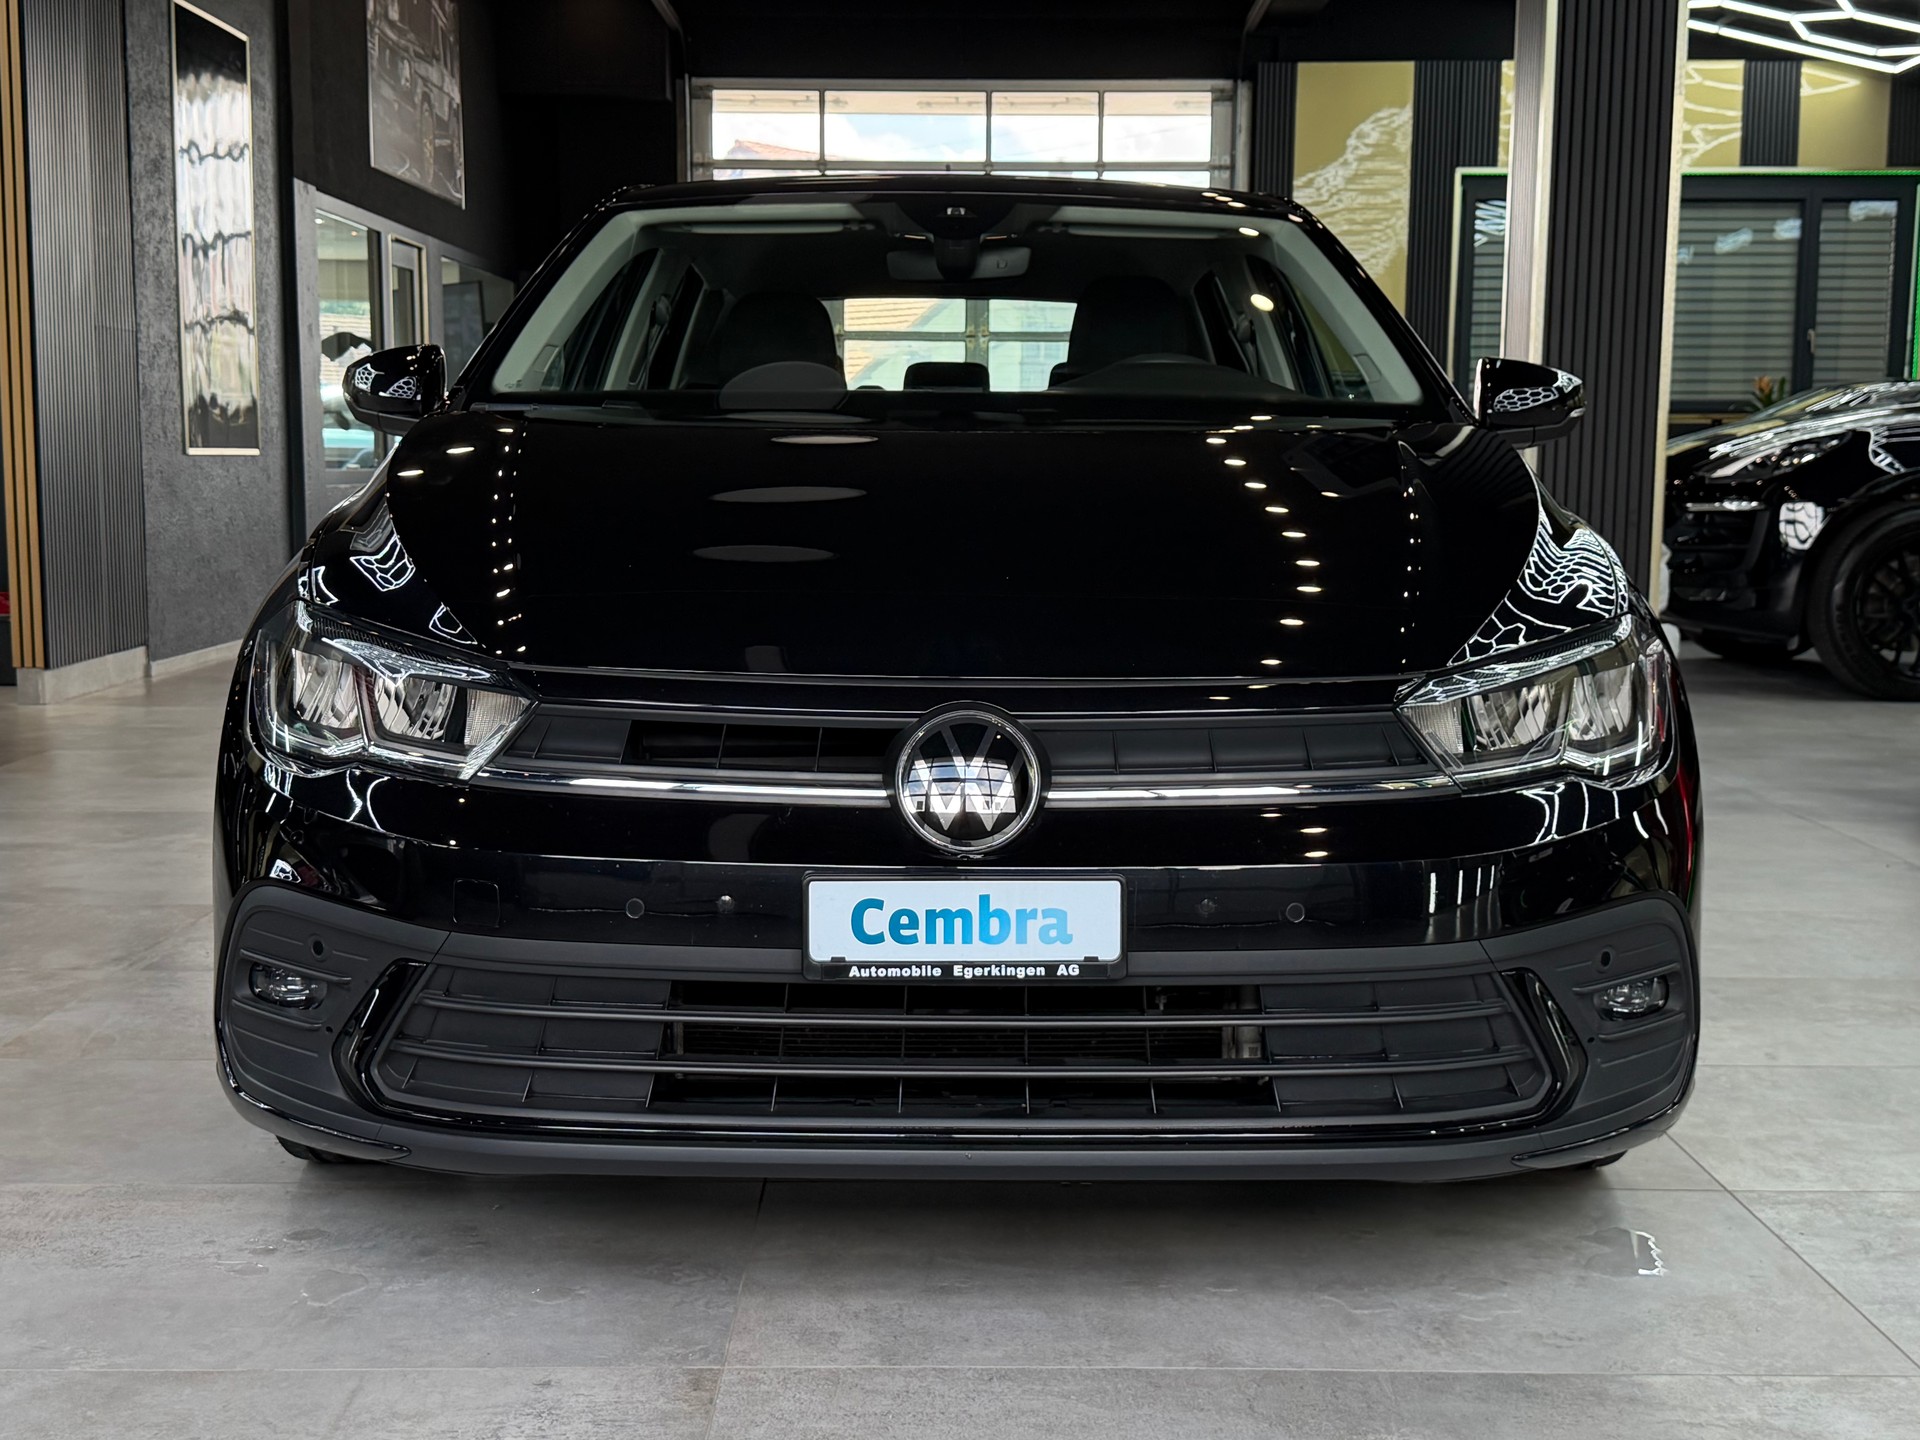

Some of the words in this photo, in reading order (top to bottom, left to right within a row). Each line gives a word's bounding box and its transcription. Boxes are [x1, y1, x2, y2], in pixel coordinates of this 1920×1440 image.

[850, 893, 1074, 946] Cembra
[848, 965, 942, 977] Automobile
[953, 965, 1046, 978] Egerkingen
[1056, 965, 1080, 976] AG
